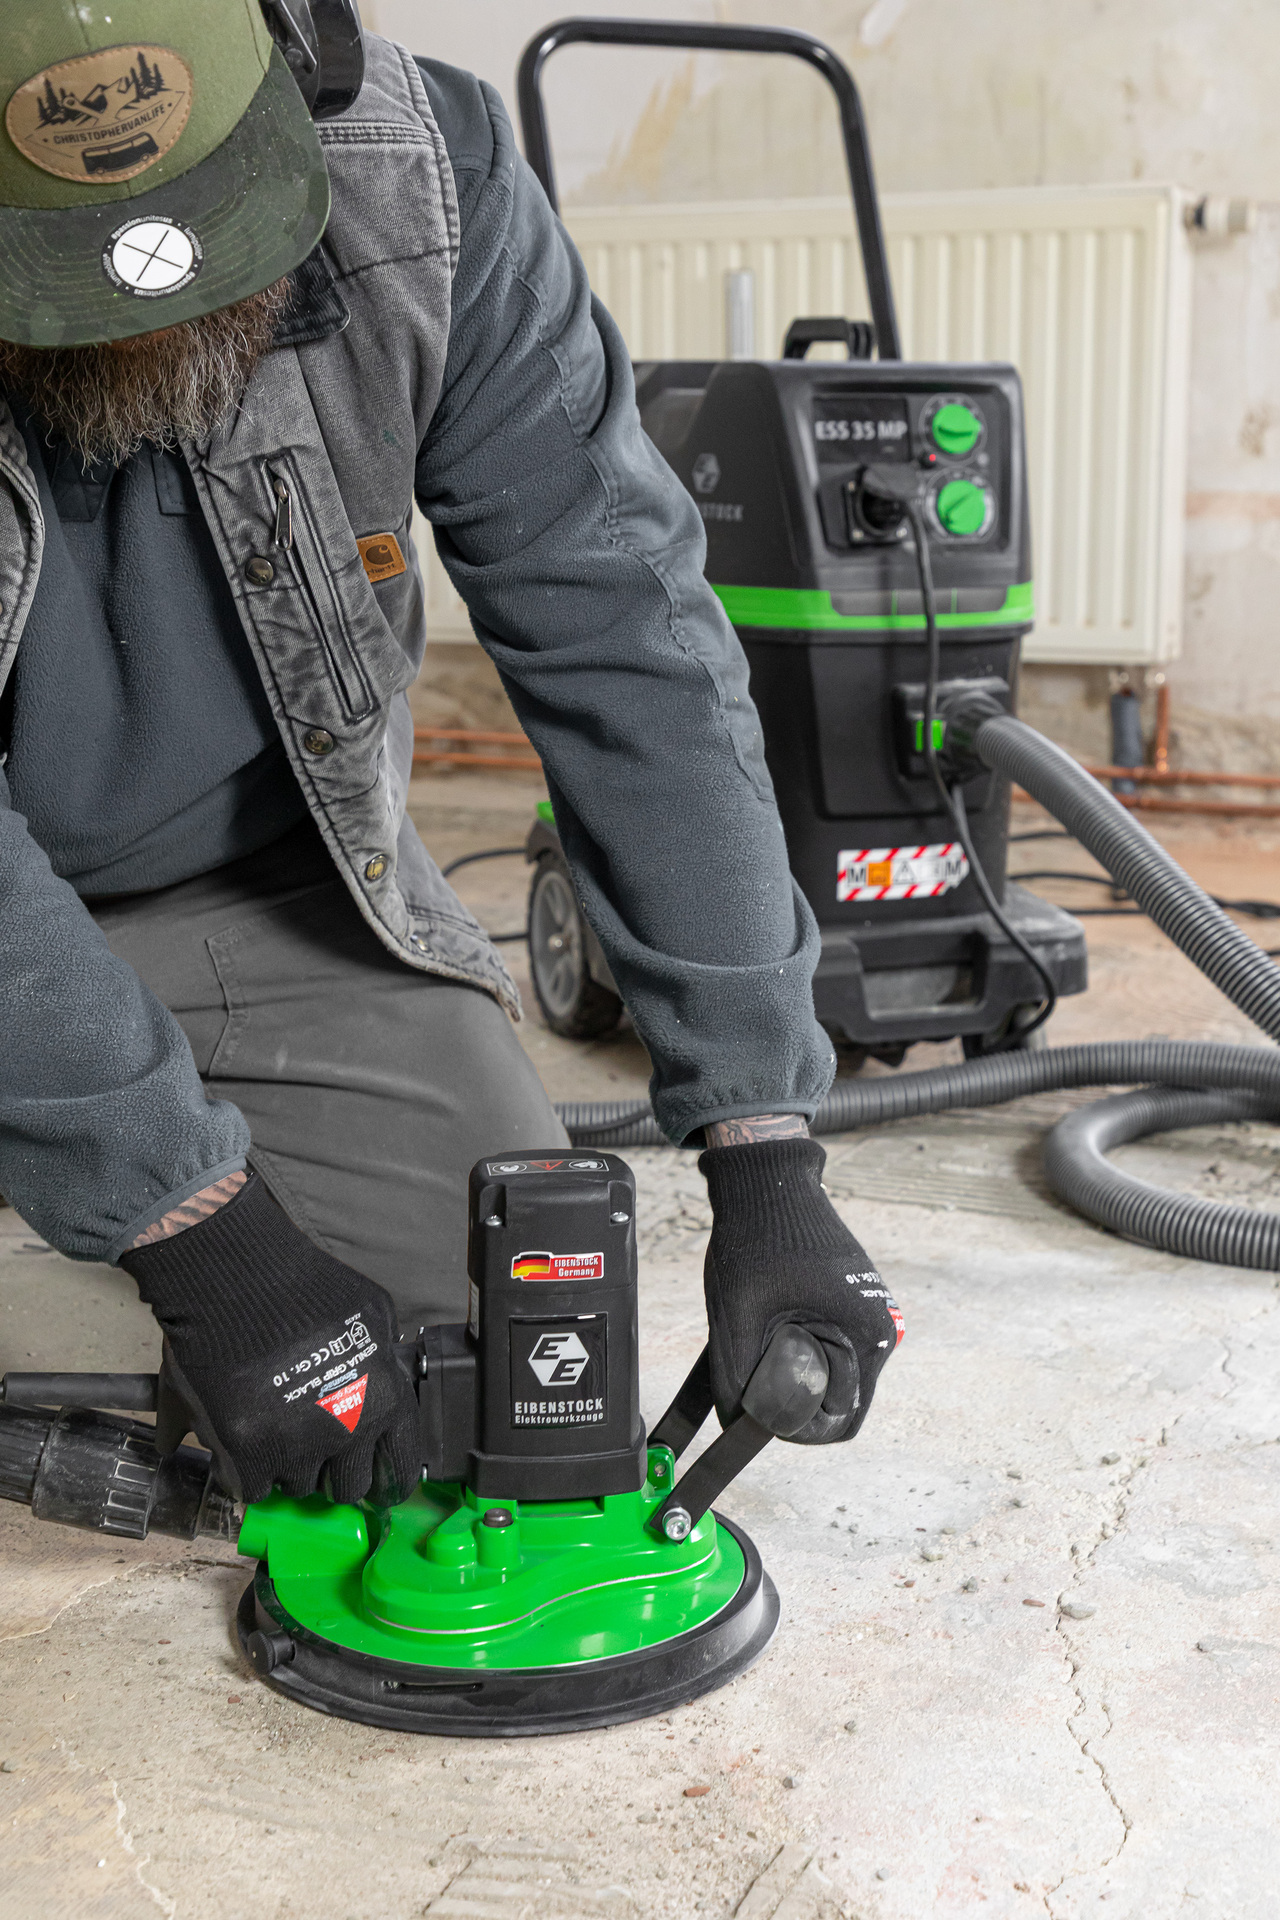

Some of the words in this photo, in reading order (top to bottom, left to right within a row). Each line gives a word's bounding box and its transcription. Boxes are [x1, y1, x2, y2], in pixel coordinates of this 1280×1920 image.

[53, 104, 165, 144] CHRISTOPHERVANLIFE
[815, 420, 850, 440] ESS
[851, 420, 876, 440] 35
[877, 420, 908, 440] MP
[554, 1257, 599, 1268] EIBENSTOCK
[558, 1268, 595, 1277] Germany
[346, 1342, 378, 1368] GENUA
[273, 1371, 290, 1387] 10
[323, 1363, 347, 1382] GRIP
[283, 1376, 323, 1404] BLACK
[331, 1391, 363, 1416] Hase
[514, 1397, 604, 1415] EIBENSTOCK
[514, 1412, 604, 1425] Elektrowerkzeuge
